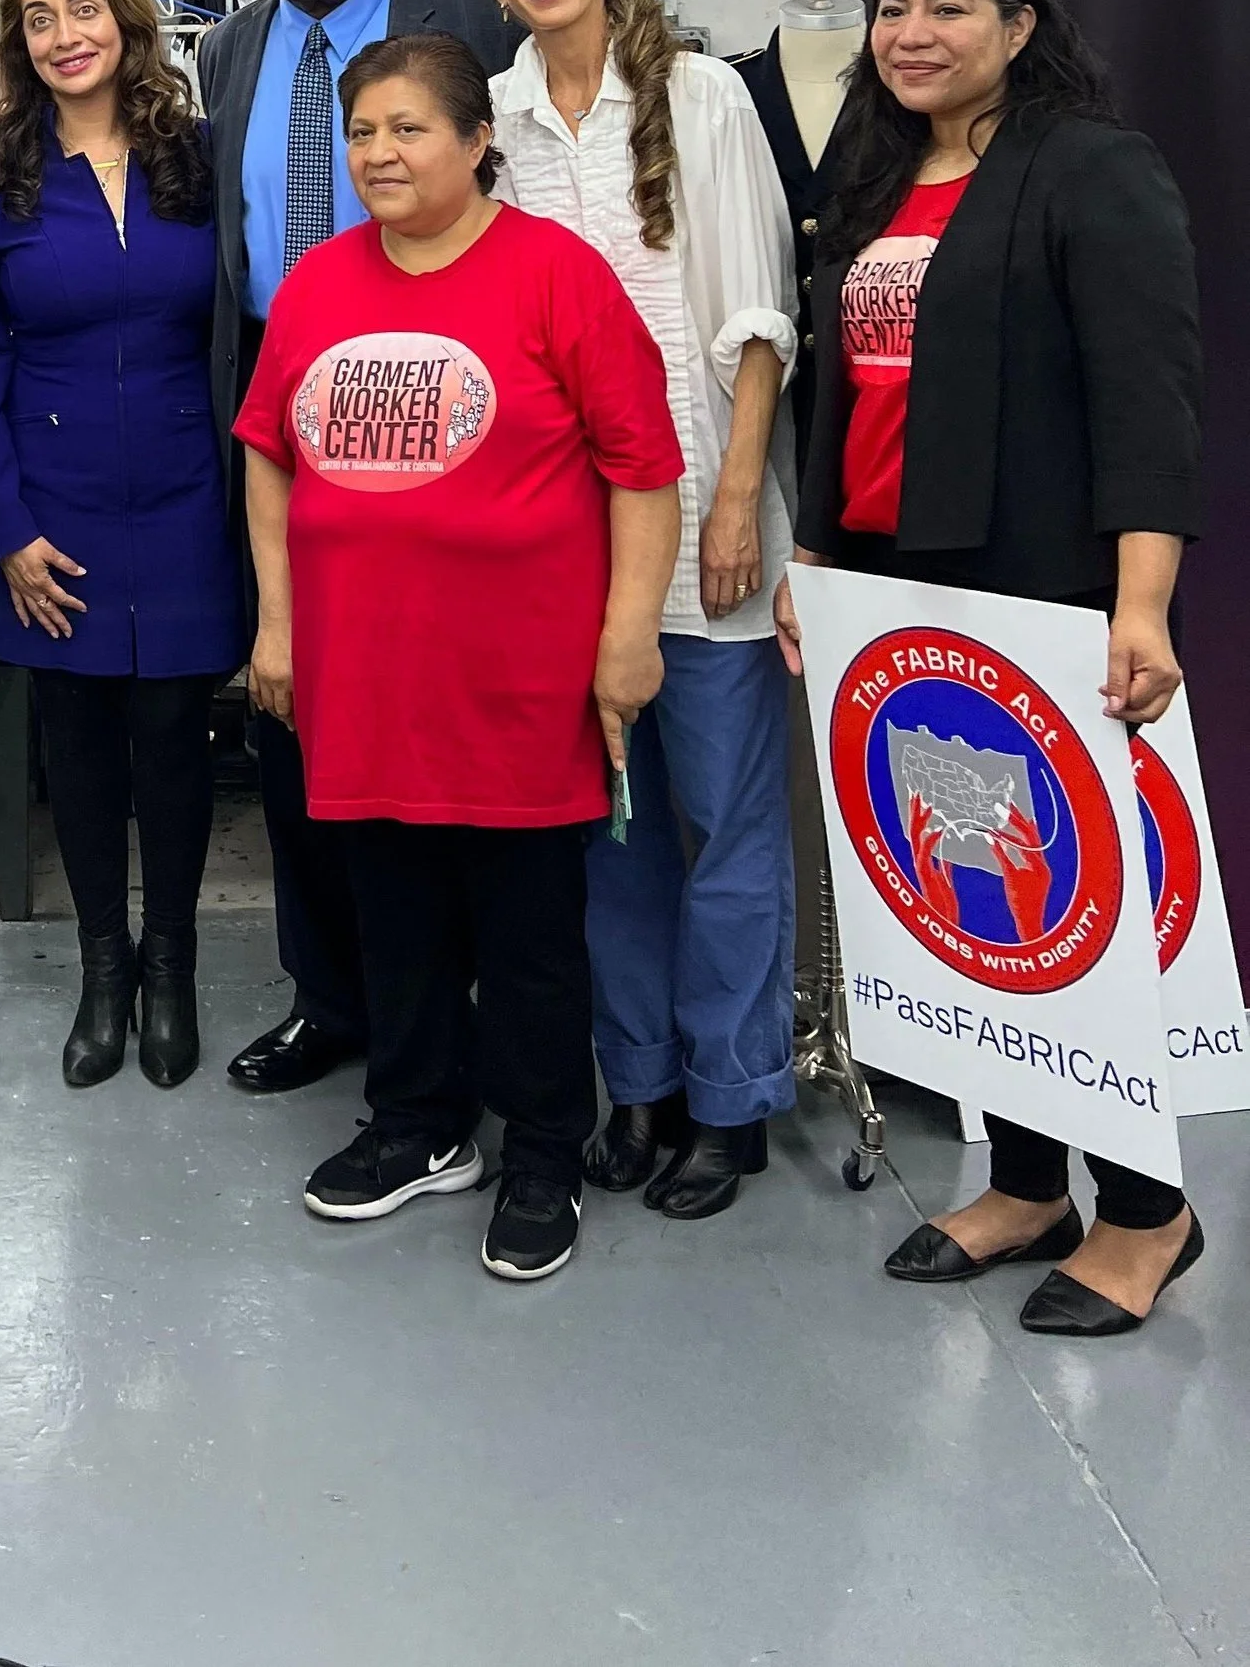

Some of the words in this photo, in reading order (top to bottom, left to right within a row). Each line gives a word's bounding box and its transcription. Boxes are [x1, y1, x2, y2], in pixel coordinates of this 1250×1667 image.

[844, 256, 934, 286] GARMENT
[841, 284, 918, 319] WORKER
[333, 357, 450, 388] GARMENT
[329, 386, 442, 422] WORKER
[324, 419, 439, 461] CENTER
[341, 460, 351, 471] DE
[851, 670, 891, 712] The
[890, 644, 1000, 691] FABRIC
[1008, 690, 1060, 751] Act
[863, 833, 915, 910] GOOD
[916, 911, 976, 961] JOBS
[978, 949, 1036, 974] WITH
[1036, 896, 1102, 972] DIGNITY
[852, 970, 1162, 1115] #PassFABRICAct
